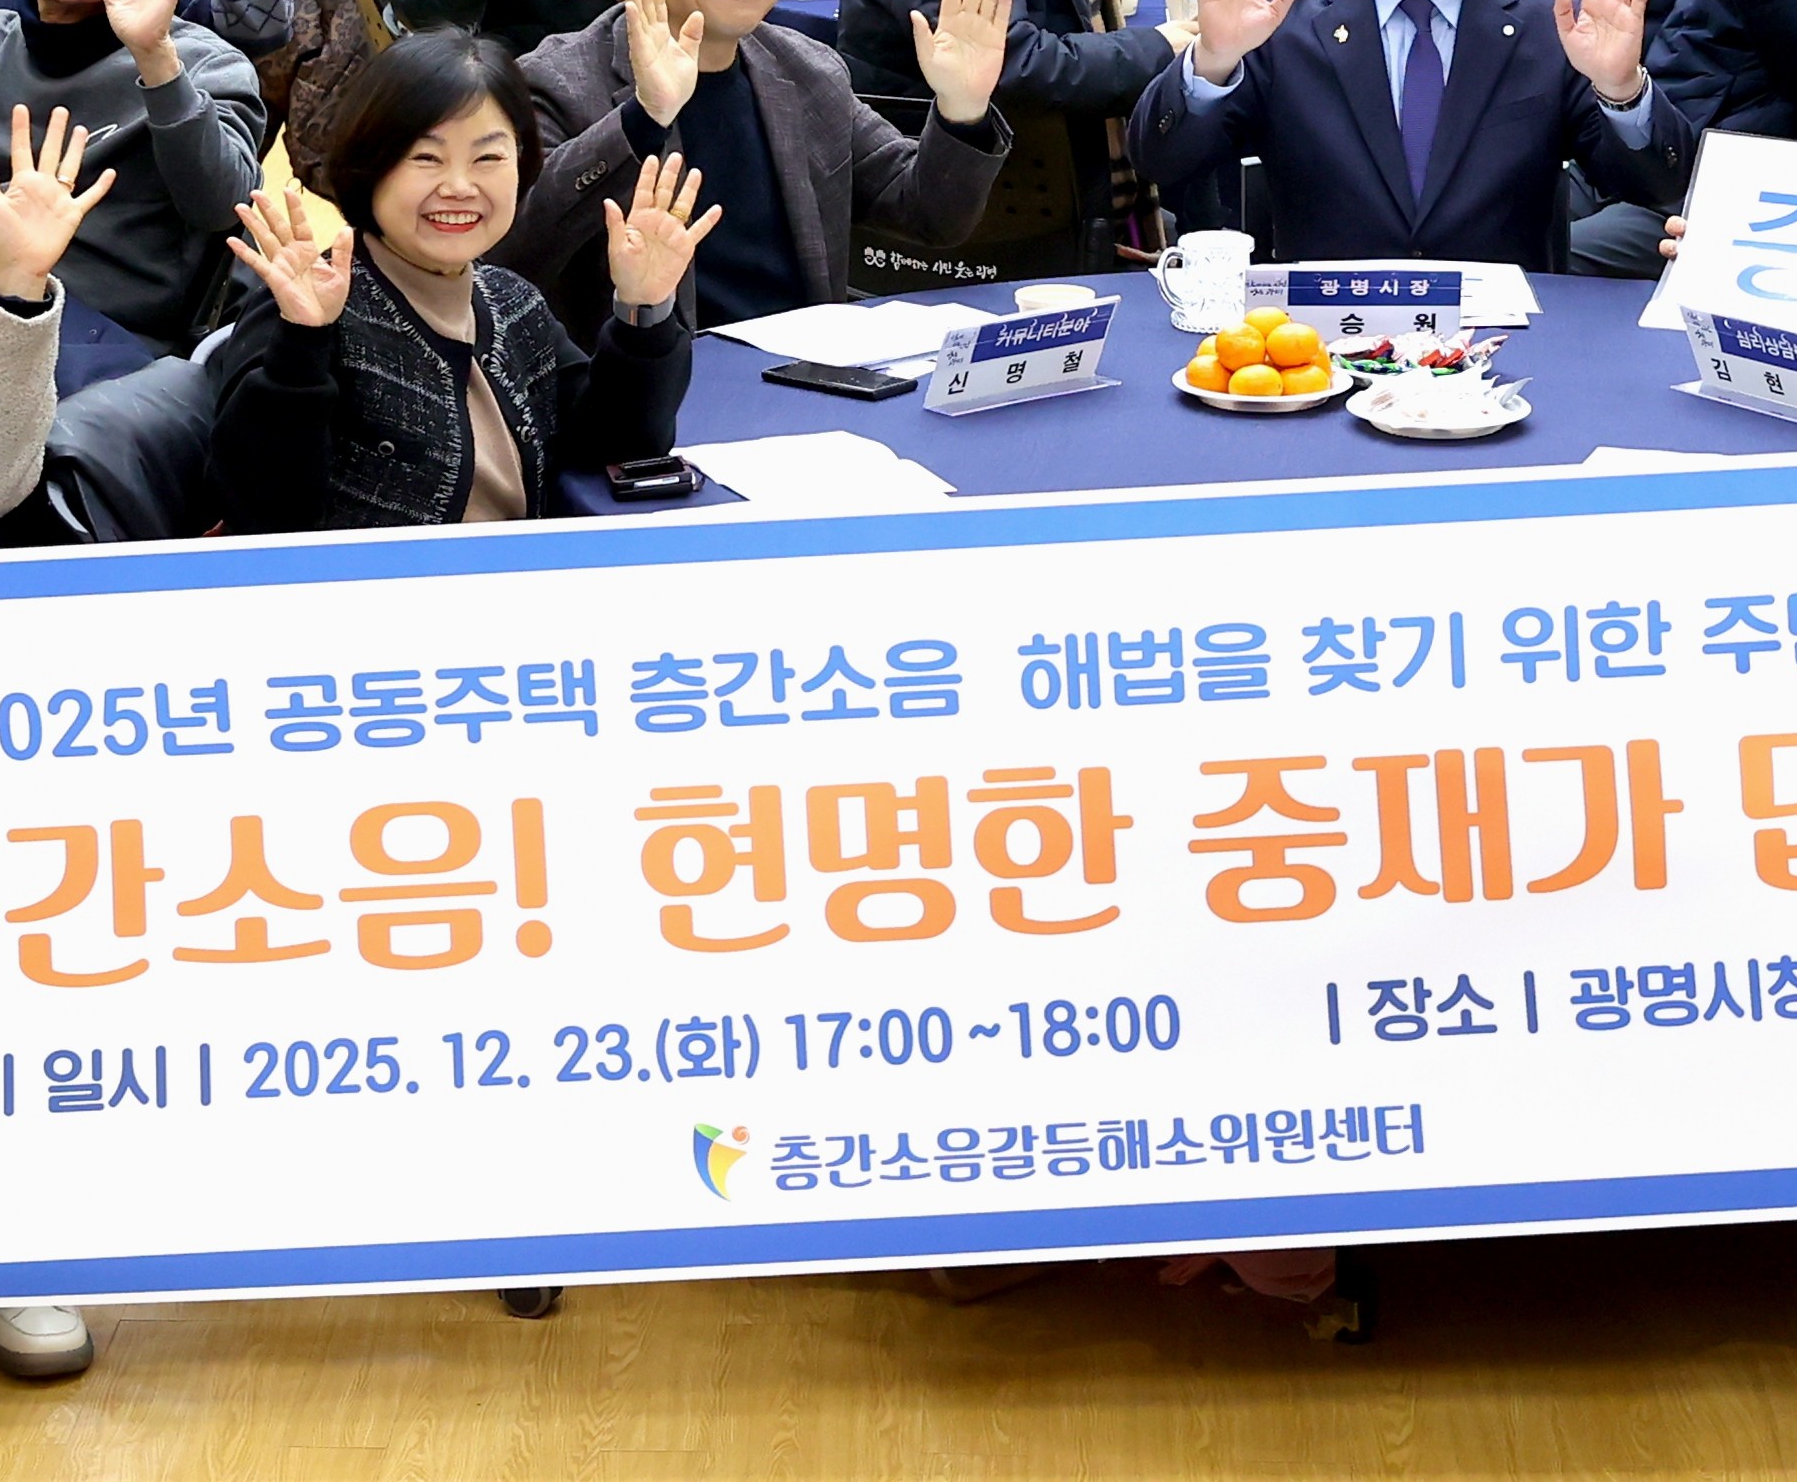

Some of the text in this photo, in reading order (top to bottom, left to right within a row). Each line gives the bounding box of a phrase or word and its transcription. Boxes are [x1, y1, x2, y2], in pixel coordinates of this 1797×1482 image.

[932, 260, 952, 275] 시민
[266, 659, 598, 752] 공동주택
[631, 640, 962, 733] 층간소음
[1018, 623, 1271, 710] 해법을
[1302, 612, 1466, 695] 찾기
[1501, 600, 1671, 683] 위한
[635, 766, 1134, 953] 현명한
[1189, 739, 1683, 923] 중재가
[1370, 975, 1497, 1041] 장소
[45, 1046, 166, 1112] 일시
[774, 1104, 1424, 1190] 층간소음갈등해소위원센터
